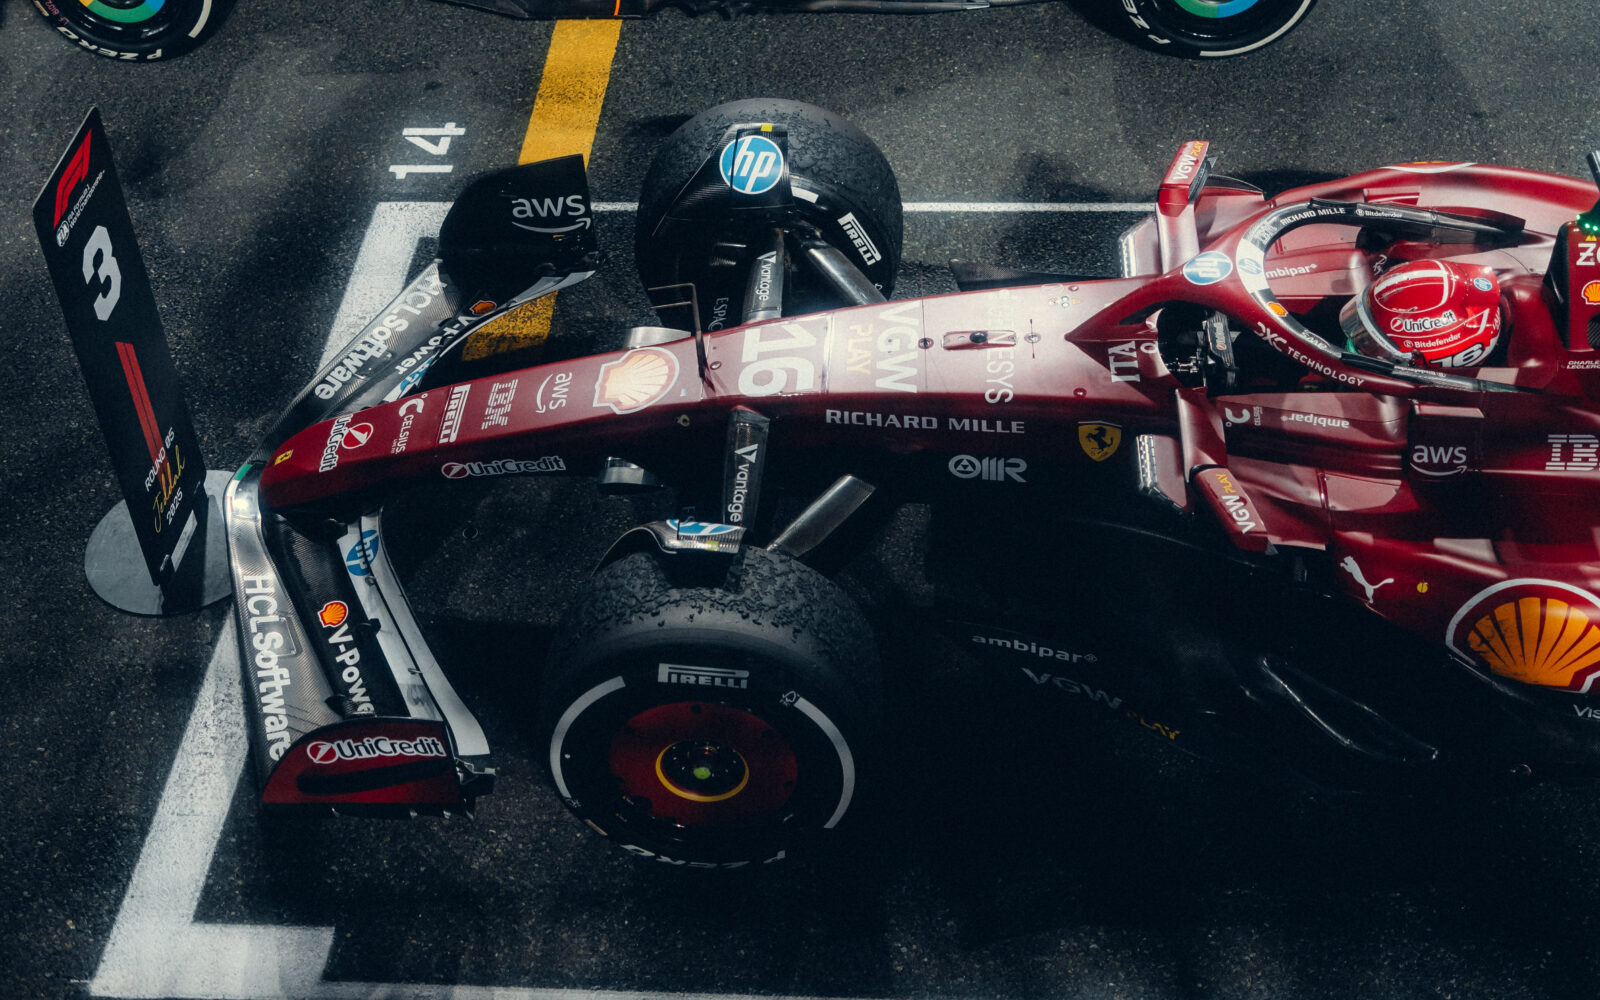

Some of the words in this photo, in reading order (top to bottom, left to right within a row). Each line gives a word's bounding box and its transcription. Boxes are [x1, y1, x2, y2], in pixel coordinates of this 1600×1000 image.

[388, 122, 466, 180] 14
[719, 135, 784, 193] hp
[1173, 152, 1198, 180] VGW
[512, 194, 586, 220] aws
[1281, 210, 1316, 226] RICHARD
[1318, 207, 1346, 216] MILLE
[837, 211, 881, 266] PIRELLI
[82, 225, 122, 321] 3
[755, 263, 771, 301] vantage
[1265, 264, 1311, 279] mbipar
[1403, 309, 1457, 332] UniCredit
[1414, 333, 1461, 348] Bitdefender
[738, 325, 817, 398] 16
[846, 323, 873, 375] PLAY
[875, 300, 920, 393] VGW
[1287, 346, 1366, 387] TECHNOLOGY
[481, 379, 519, 430] IBM
[549, 372, 573, 410] aws
[439, 384, 471, 444] PIRELLI
[825, 409, 938, 430] RICHARD
[948, 417, 1025, 434] MILLE
[319, 413, 353, 473] UniCredit
[396, 415, 414, 454] CELSIUS
[1545, 434, 1600, 471] IB
[144, 447, 166, 492] ROUND
[469, 456, 566, 475] UniCredit
[1412, 446, 1467, 464] aws
[727, 463, 751, 523] vantage
[1222, 494, 1256, 535] VGW
[243, 574, 293, 763] HCLSoftware
[328, 622, 375, 713] V-Powe
[971, 635, 1083, 663] ambipar
[657, 663, 750, 689] PIRELLI
[337, 737, 446, 760] UniCredit
